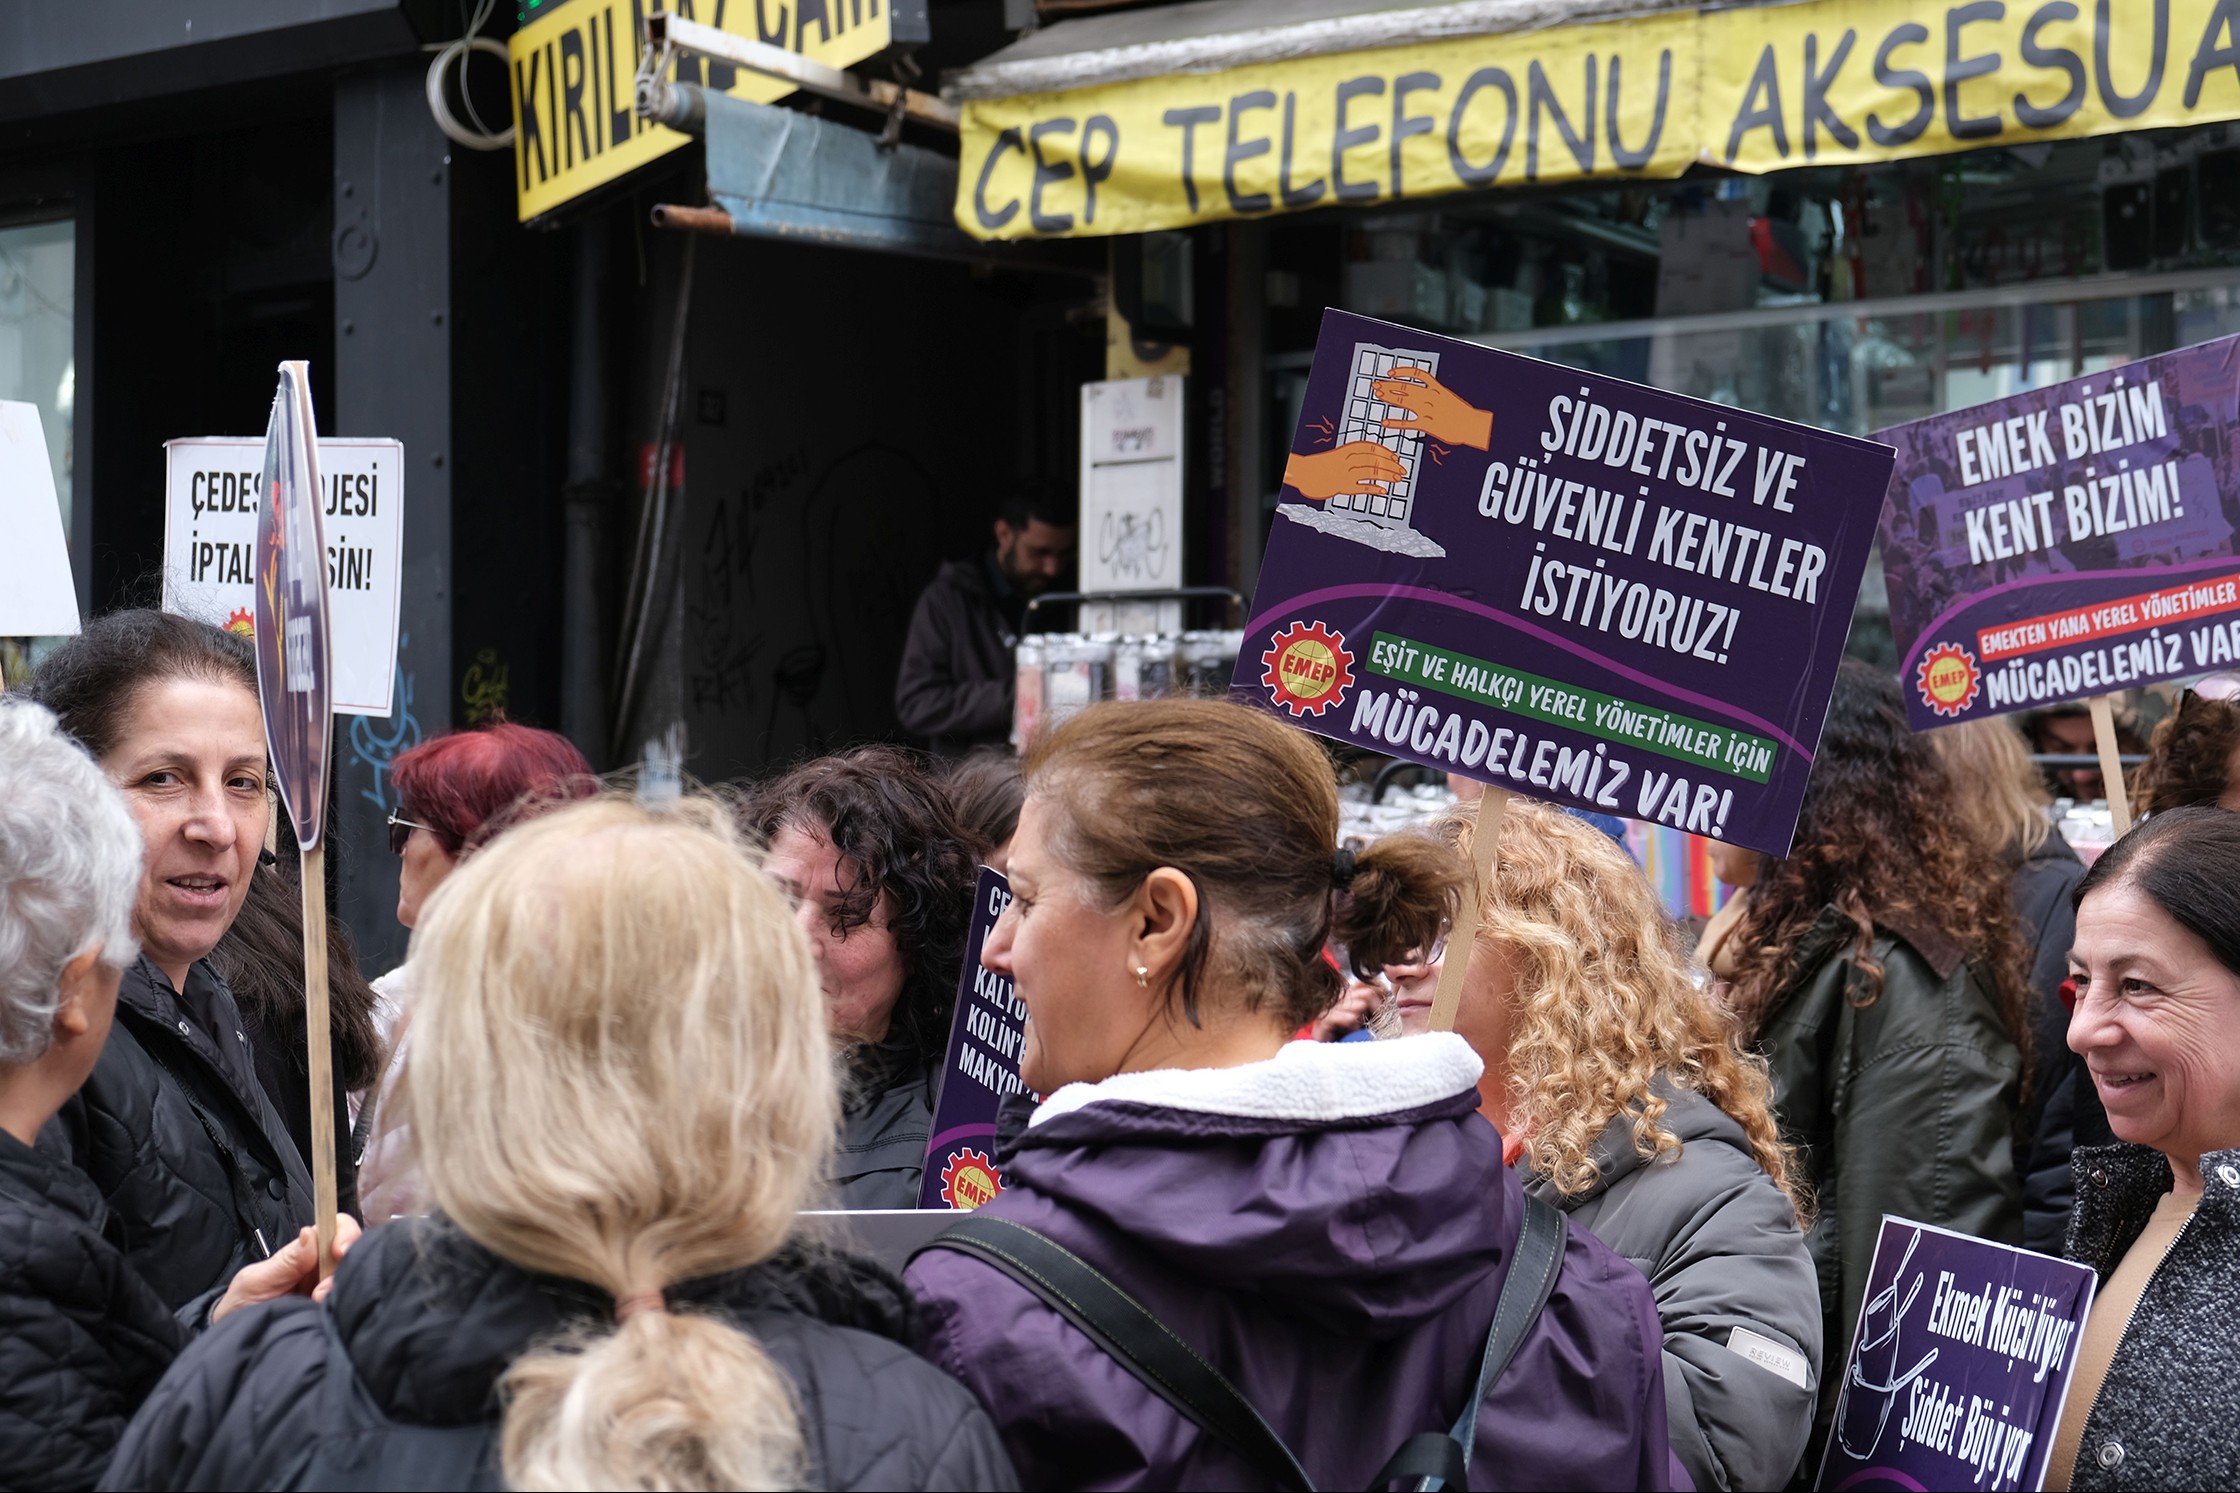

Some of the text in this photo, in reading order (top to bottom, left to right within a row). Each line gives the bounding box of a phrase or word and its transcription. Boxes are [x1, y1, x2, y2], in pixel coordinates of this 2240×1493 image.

[973, 114, 1119, 232] CEP
[1163, 48, 1672, 214] TELEFONU
[1540, 387, 1806, 514] ŞİDDETSİZ VE
[1956, 376, 2167, 487] EMEK BİZİM
[190, 530, 254, 585] İPTAL
[1478, 456, 1827, 605] GÜVENLİ KENTLER
[1965, 458, 2184, 565] KENT BİZİM!
[1520, 541, 1741, 665] İSTİYORUZ!
[1981, 583, 2238, 655] EMEKTEN YANA YEREL YÖNETİMLER
[1282, 654, 1335, 683] EMEP
[1371, 640, 1772, 774] EŞİT VE HALKÇI YEREL YÖNETİMLER İÇİN
[1932, 669, 1966, 689] EMEP
[1986, 627, 2184, 709] MÜCADELEMİZ
[1349, 688, 1734, 839] MÜCADELEMİZ VAR!
[1927, 1270, 1992, 1347] Ekmek
[1899, 1375, 1964, 1456] Şiddet
